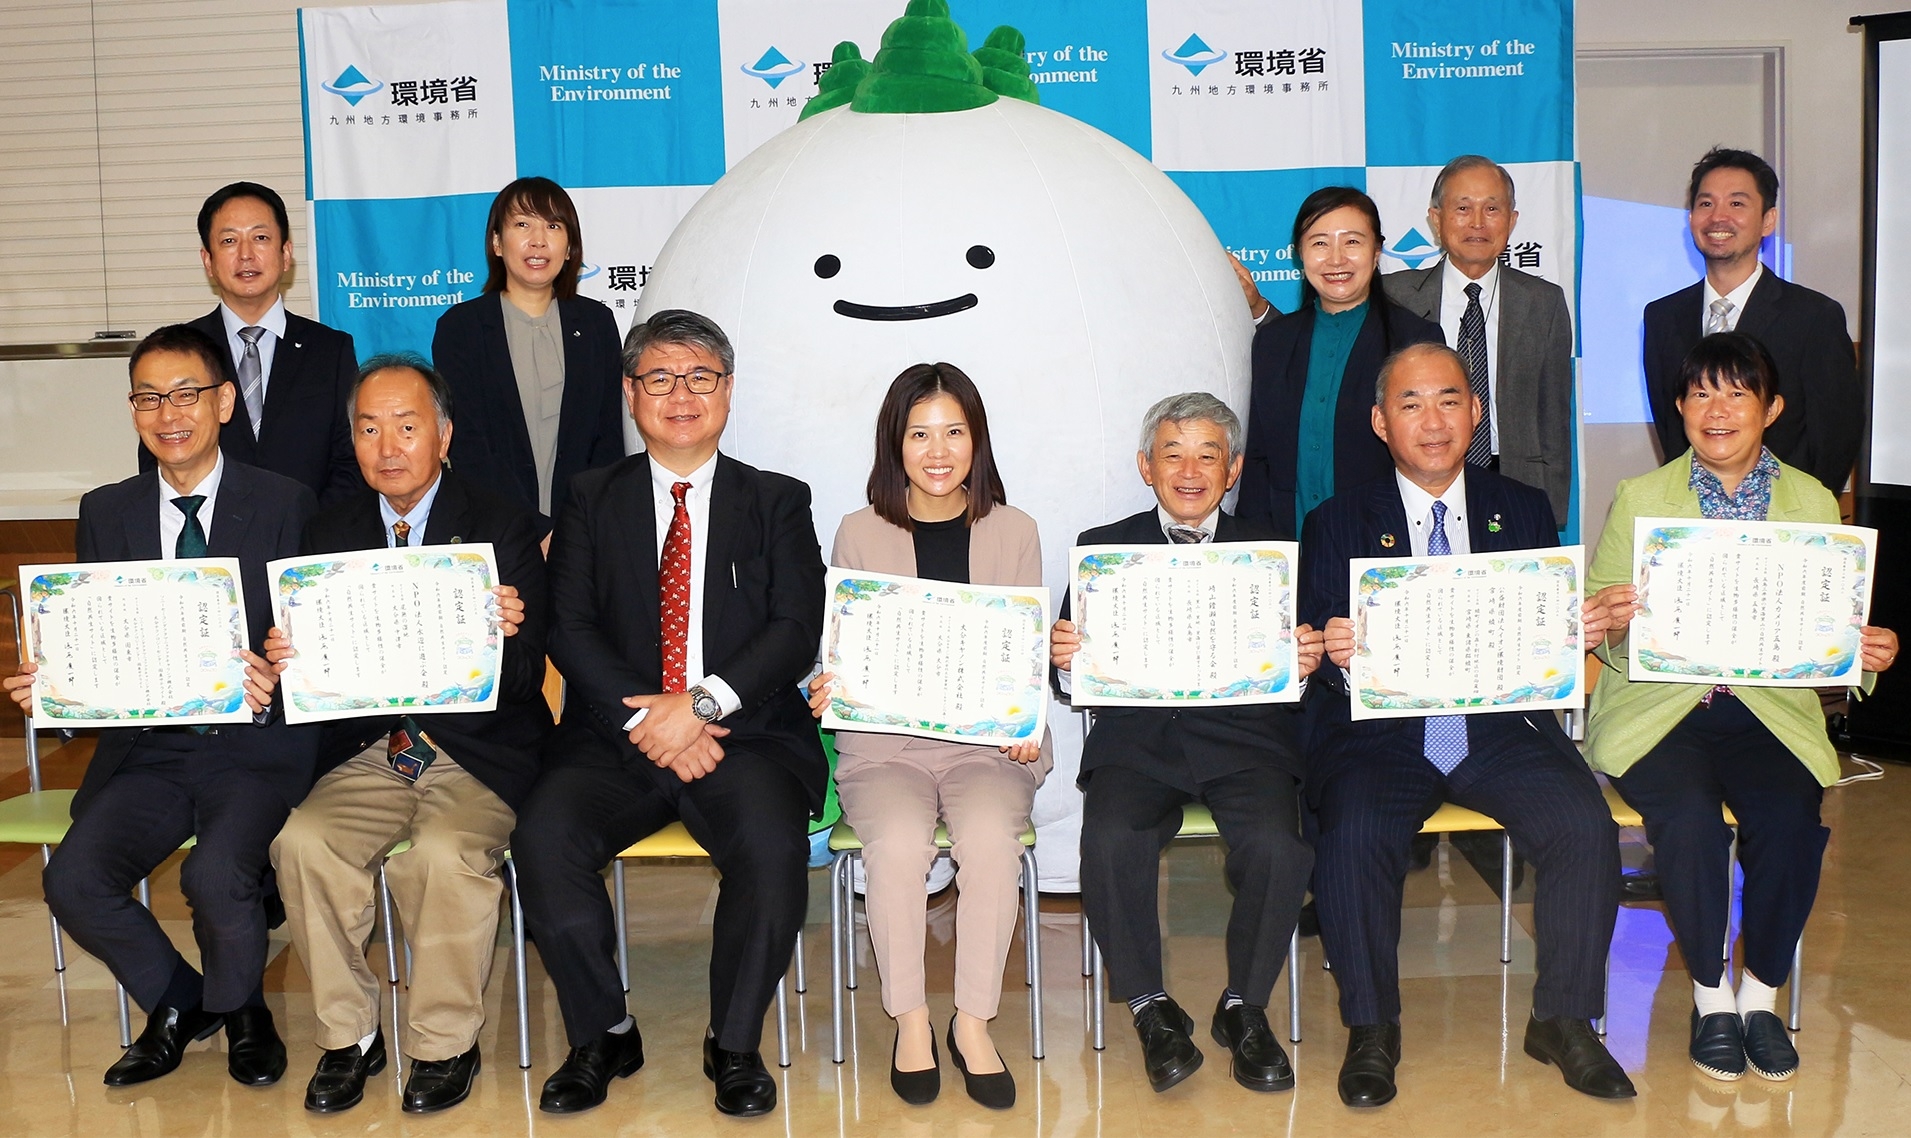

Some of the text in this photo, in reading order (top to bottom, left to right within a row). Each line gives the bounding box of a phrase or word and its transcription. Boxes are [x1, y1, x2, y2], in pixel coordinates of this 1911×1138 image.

[1053, 45, 1073, 62] of
[1079, 46, 1108, 62] the
[1393, 40, 1534, 60] Ministry of the
[1235, 48, 1326, 76] 環境省
[1404, 59, 1523, 78] Environment
[541, 64, 680, 83] Ministry of the
[1028, 68, 1098, 85] onment
[391, 76, 477, 106] 環境省
[552, 82, 670, 101] Environment
[1173, 81, 1328, 95] 九州地方環境事務所
[330, 109, 477, 125] 九州地方環境事務所
[1275, 244, 1295, 260] of
[338, 269, 473, 290] Ministry of the
[350, 289, 462, 307] Environment
[1820, 567, 1832, 602] 認定証
[453, 588, 466, 624] 認定証
[1250, 584, 1259, 619] 認定証
[1536, 592, 1547, 626] 認定証
[198, 602, 209, 637] 認定証
[1001, 628, 1012, 662] 認定証
